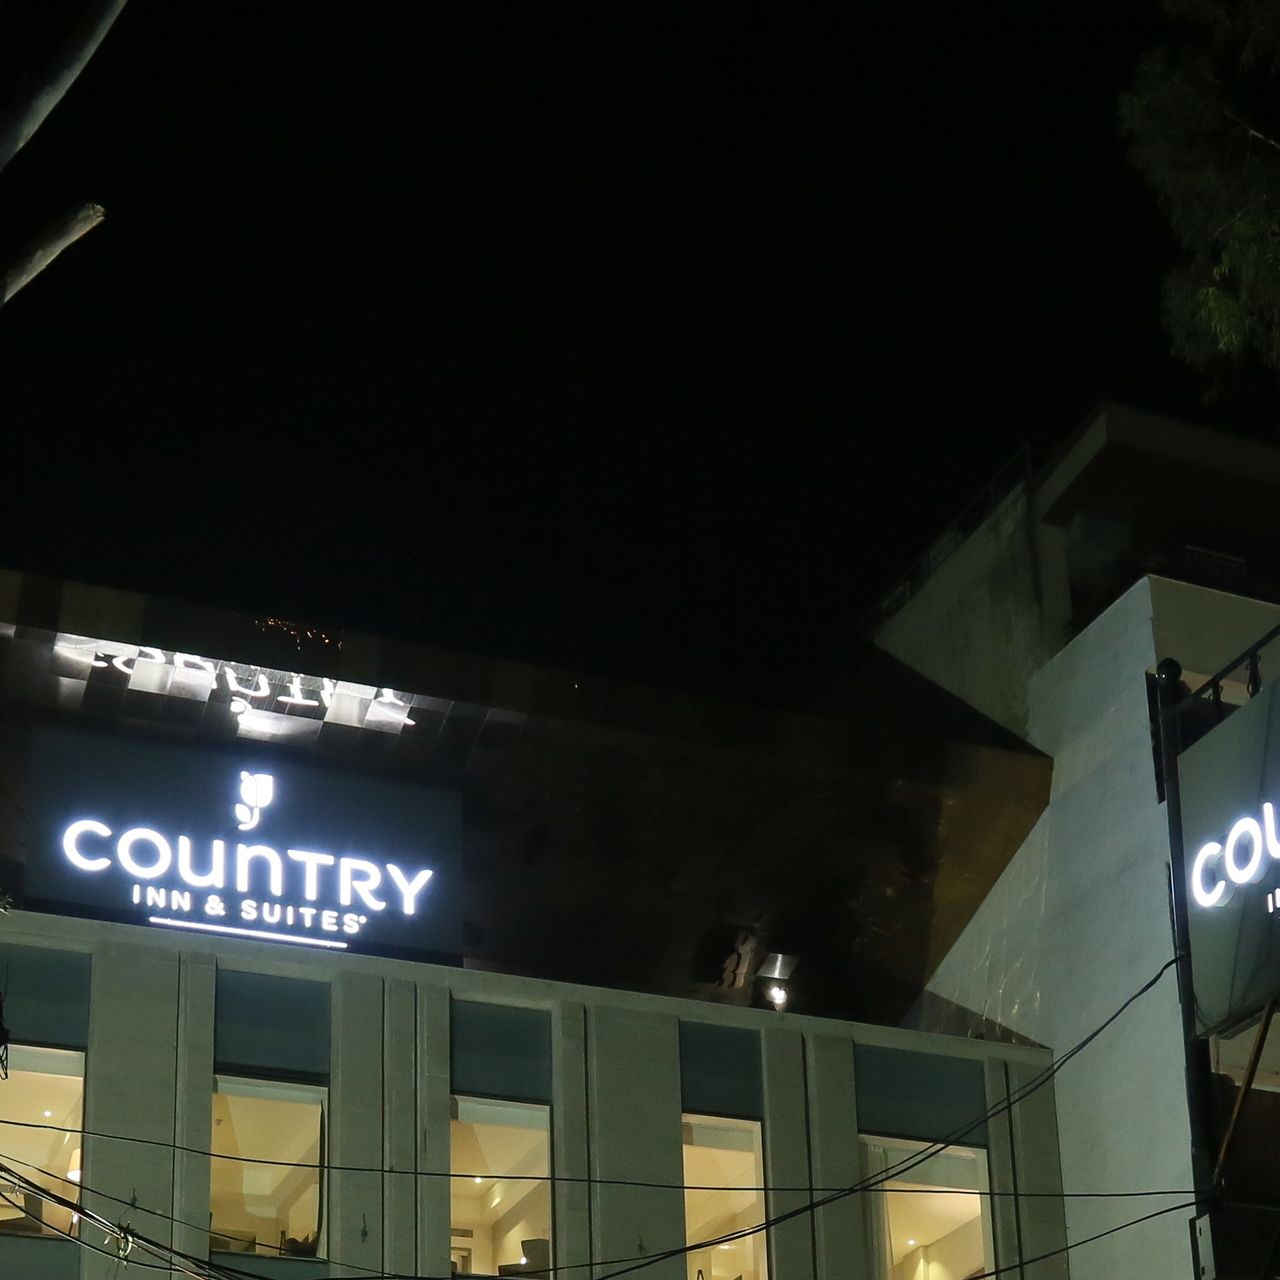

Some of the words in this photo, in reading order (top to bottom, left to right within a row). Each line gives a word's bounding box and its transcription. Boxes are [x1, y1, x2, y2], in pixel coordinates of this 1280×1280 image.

[62, 820, 434, 914] COUNTRY
[132, 884, 191, 912] INN
[204, 894, 226, 916] &
[240, 899, 360, 934] SUITES
